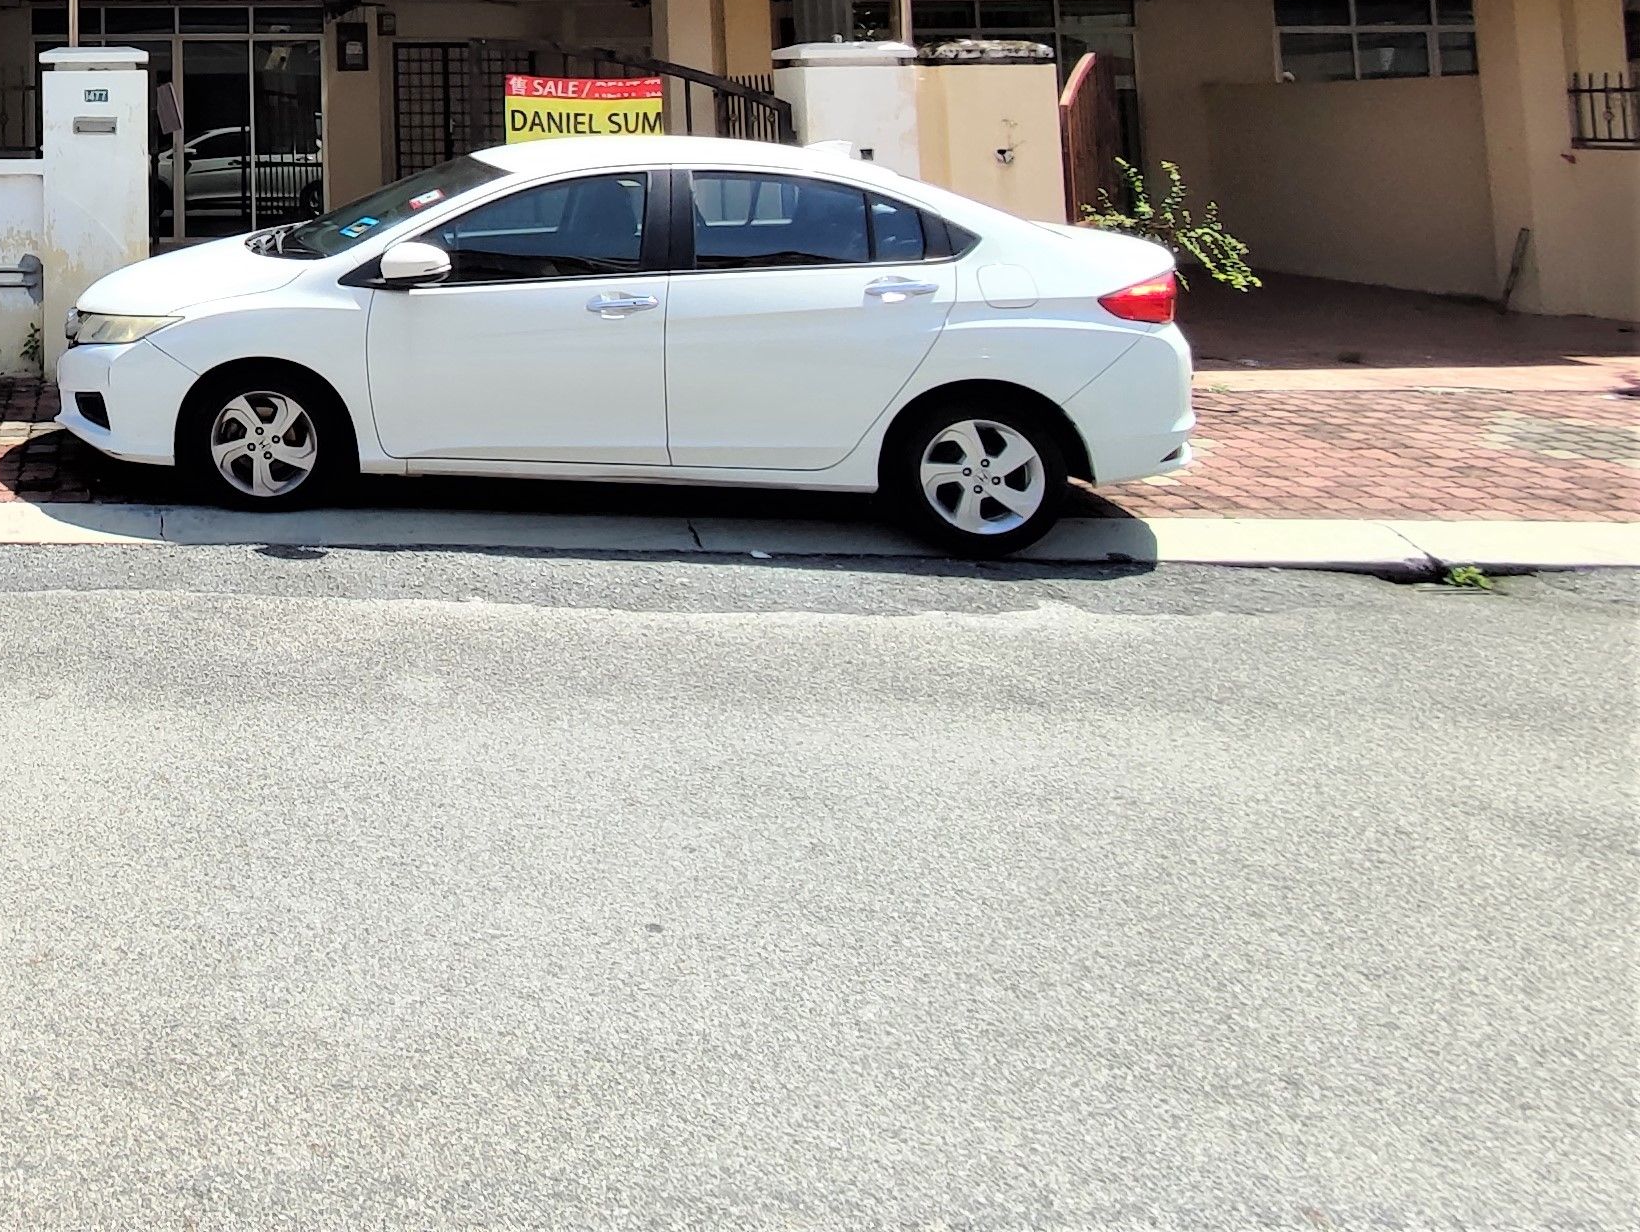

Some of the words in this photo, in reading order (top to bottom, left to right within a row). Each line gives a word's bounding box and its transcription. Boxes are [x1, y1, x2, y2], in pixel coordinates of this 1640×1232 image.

[531, 79, 579, 97] SALE
[511, 109, 601, 134] DANIEL
[607, 112, 662, 134] SUM
